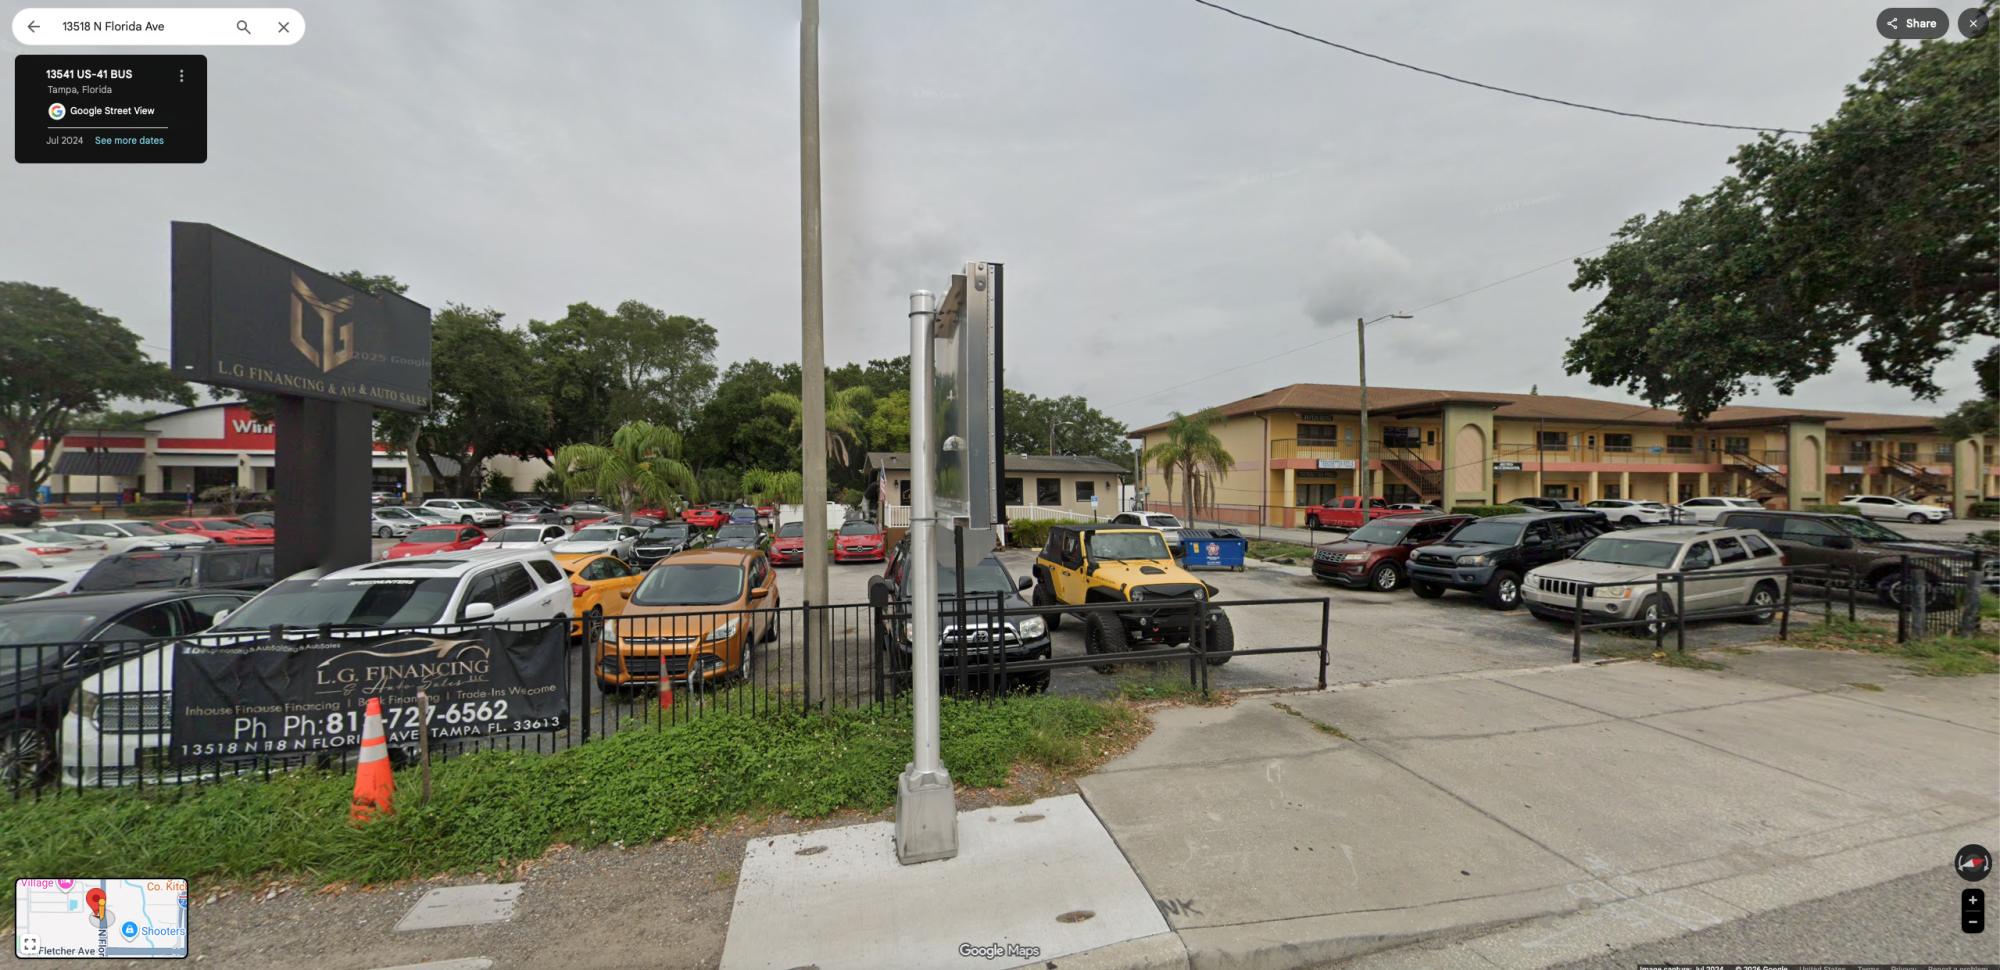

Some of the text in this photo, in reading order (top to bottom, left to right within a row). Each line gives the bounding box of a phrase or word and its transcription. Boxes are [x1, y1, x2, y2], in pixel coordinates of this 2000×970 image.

[249, 367, 325, 393] FINANCING
[358, 383, 368, 395] &
[369, 386, 398, 401] AUTO
[399, 392, 428, 407] SALES
[317, 660, 490, 685] L.G. FINANCING
[185, 706, 233, 716] Inhouse
[456, 688, 507, 700] Trade-Ins
[181, 742, 238, 756] 13518
[244, 741, 258, 753] N
[294, 739, 307, 750] N
[389, 729, 419, 742] AVE
[431, 725, 481, 738] TAMPA
[488, 722, 507, 733] FL.
[513, 716, 560, 731] 33613
[234, 716, 268, 740] Ph
